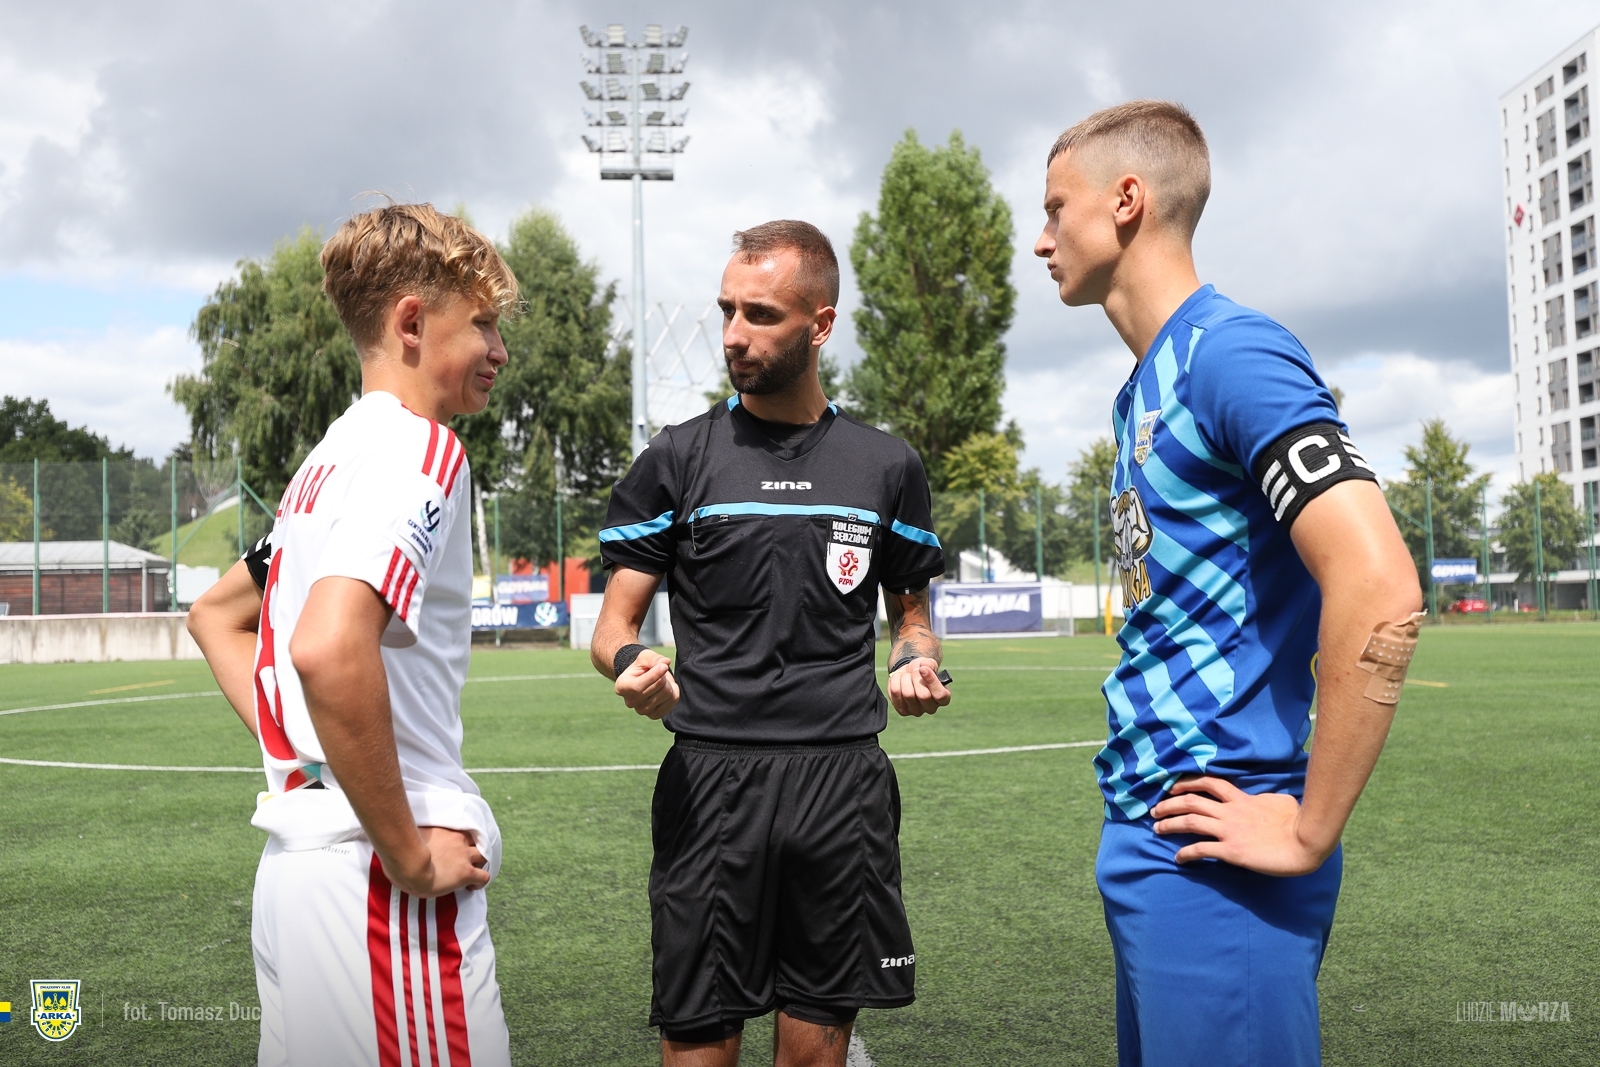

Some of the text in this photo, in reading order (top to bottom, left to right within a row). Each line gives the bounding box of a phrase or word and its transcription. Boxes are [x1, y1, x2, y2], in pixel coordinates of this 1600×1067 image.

[1288, 434, 1342, 484] C
[832, 520, 873, 536] KOLEGIUM
[832, 531, 870, 545] SĘDZIÓW
[838, 577, 854, 587] PZPN
[934, 593, 1031, 619] GDYNIA
